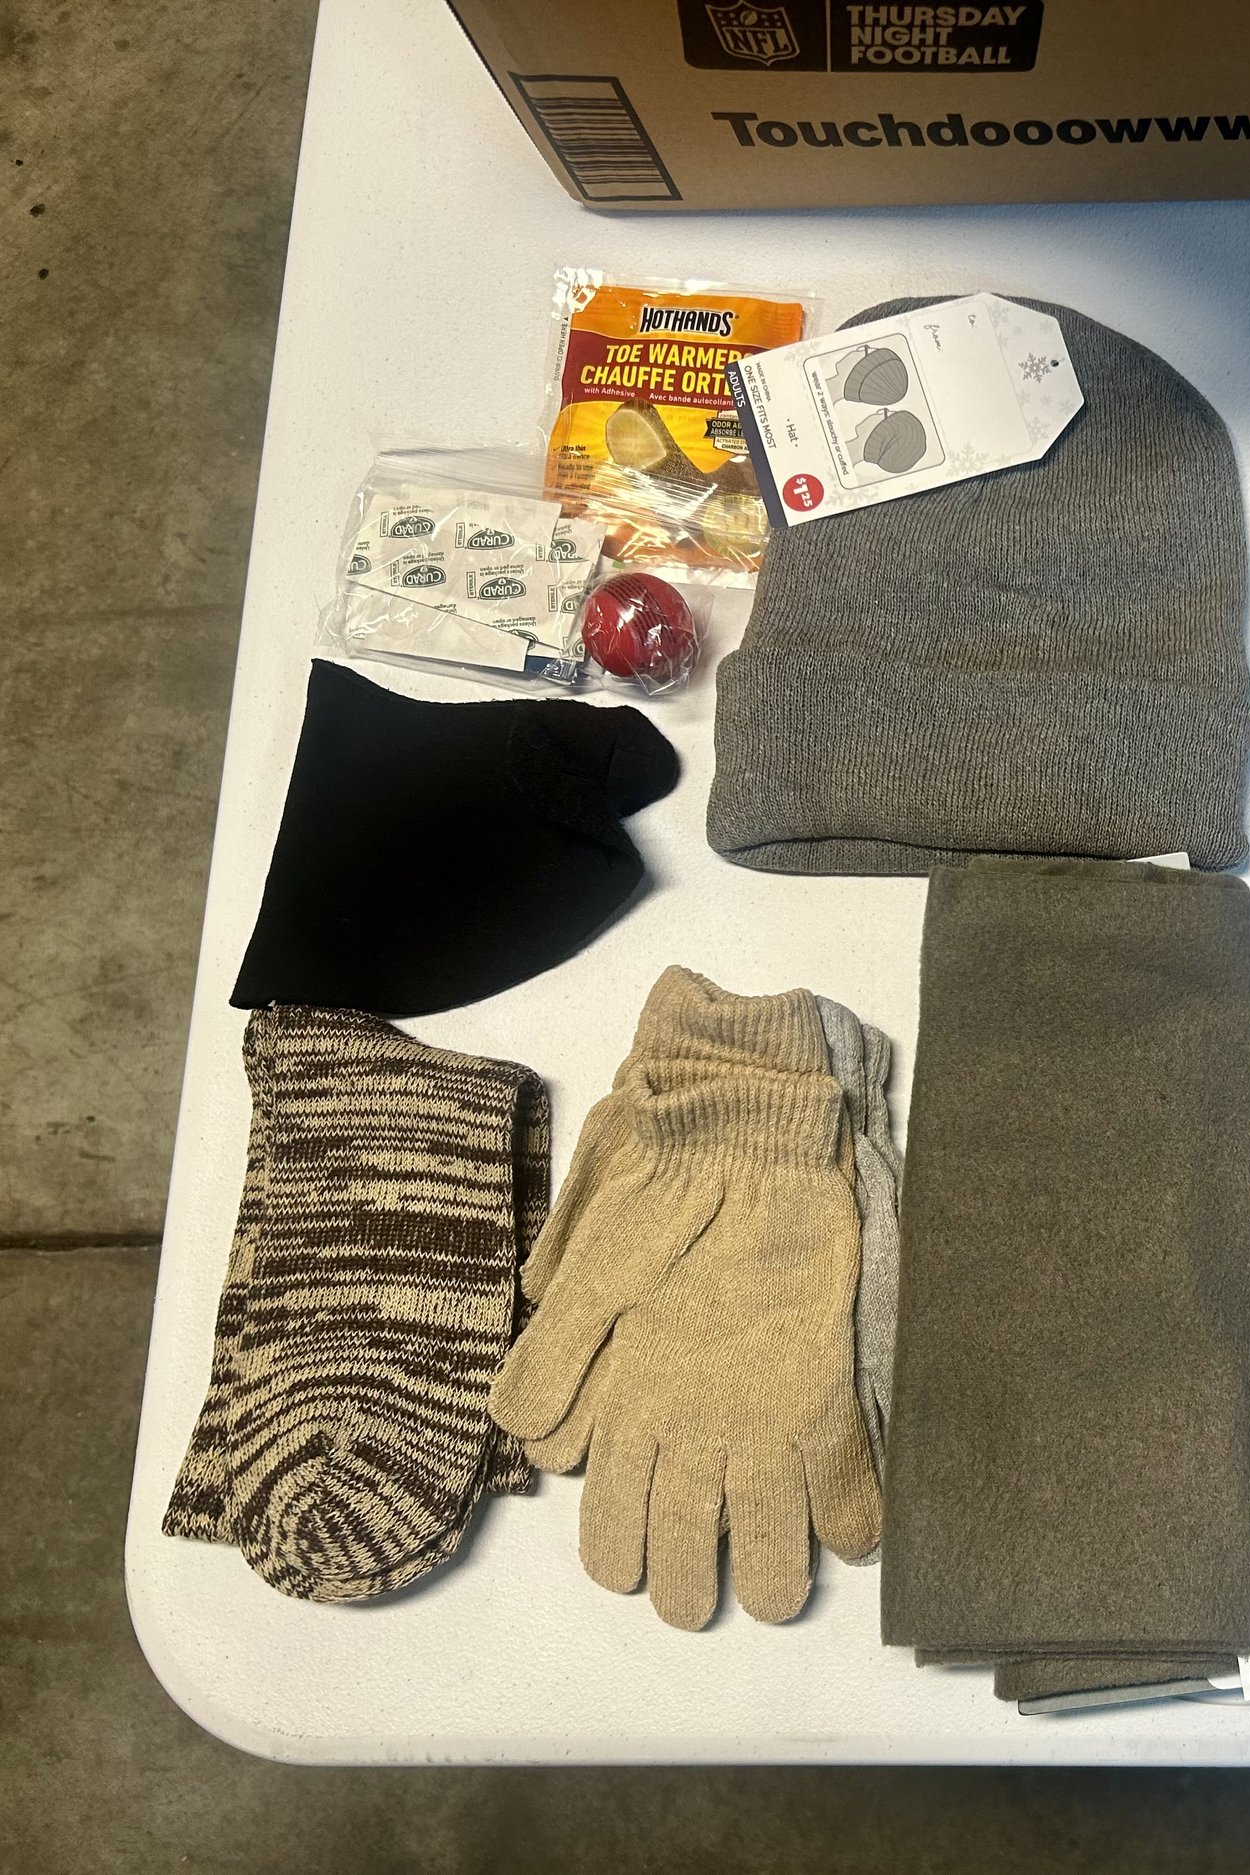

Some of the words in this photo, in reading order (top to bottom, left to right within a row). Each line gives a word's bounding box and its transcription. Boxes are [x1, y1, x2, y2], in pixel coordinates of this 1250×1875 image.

[847, 5, 1027, 26] THURSDAY
[726, 28, 790, 53] NFL
[850, 26, 953, 46] NIGHT
[850, 46, 1011, 65] FOOTBALL
[639, 307, 734, 337] HOTHANDS
[606, 344, 644, 364] TOE
[649, 343, 753, 370] WARMER
[580, 365, 677, 392] CHAUFFE
[744, 365, 756, 385] ONE
[601, 387, 636, 398] Adhesive
[649, 393, 667, 401] Avec
[669, 395, 692, 404] bande
[692, 397, 735, 406] autocollant
[728, 371, 746, 408] ADULTS
[750, 385, 763, 405] SIZE
[756, 404, 768, 424] FITS
[711, 420, 732, 429] ODOR
[786, 424, 799, 442] Hat
[763, 424, 777, 448] MOST
[472, 534, 510, 547] CURAD
[406, 571, 442, 585] CURAD
[483, 583, 522, 597] CURAD
